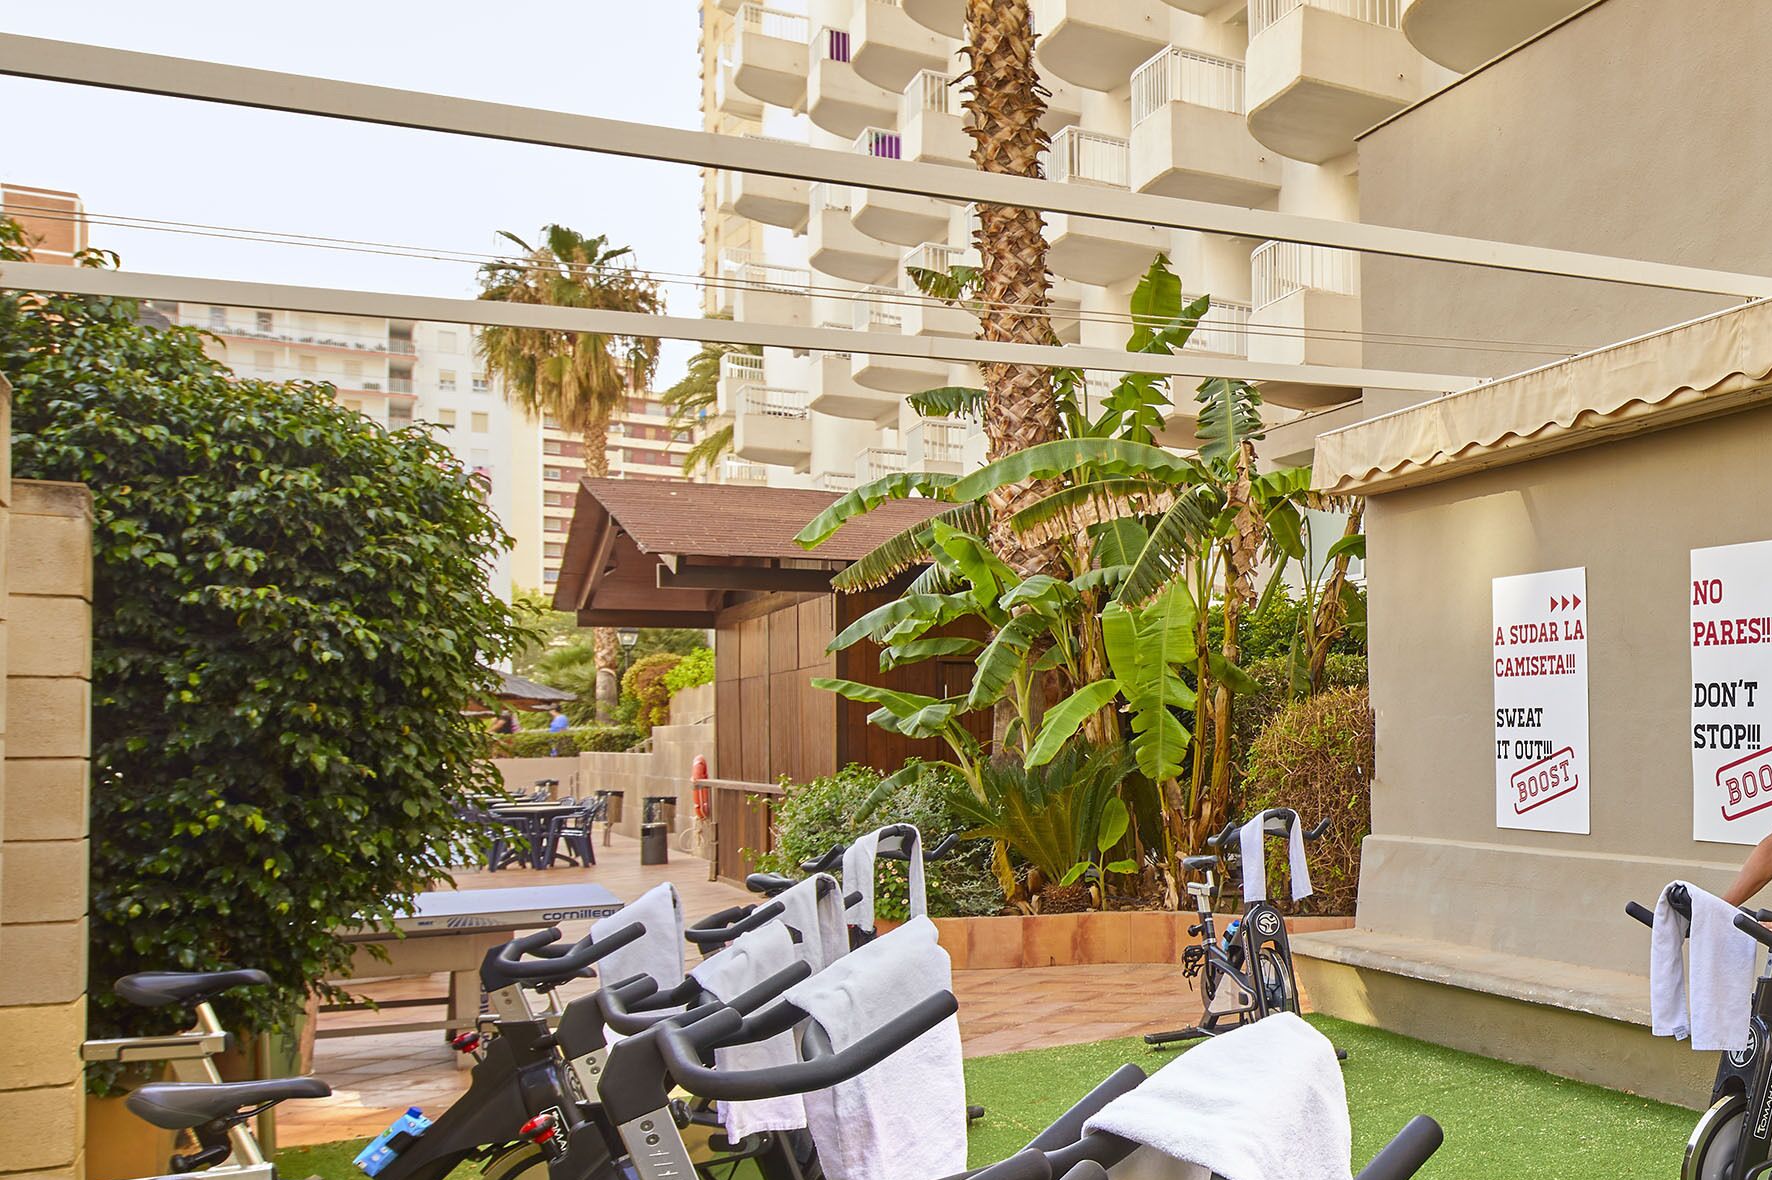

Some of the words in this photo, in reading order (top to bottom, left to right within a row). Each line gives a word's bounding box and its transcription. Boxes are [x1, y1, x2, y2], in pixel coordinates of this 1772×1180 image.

[1693, 579, 1722, 605] NO
[1495, 626, 1505, 646] A
[1510, 622, 1559, 645] SUDAR
[1564, 620, 1584, 641] LA
[1495, 654, 1576, 677] CAMISETA!!!
[1694, 679, 1758, 708] DON'T
[1496, 707, 1543, 728] SWEAT
[1497, 740, 1510, 760] IT
[1515, 740, 1553, 760] OUT!!!
[1693, 724, 1761, 750] STOP!!!
[1517, 759, 1570, 803] BOOST
